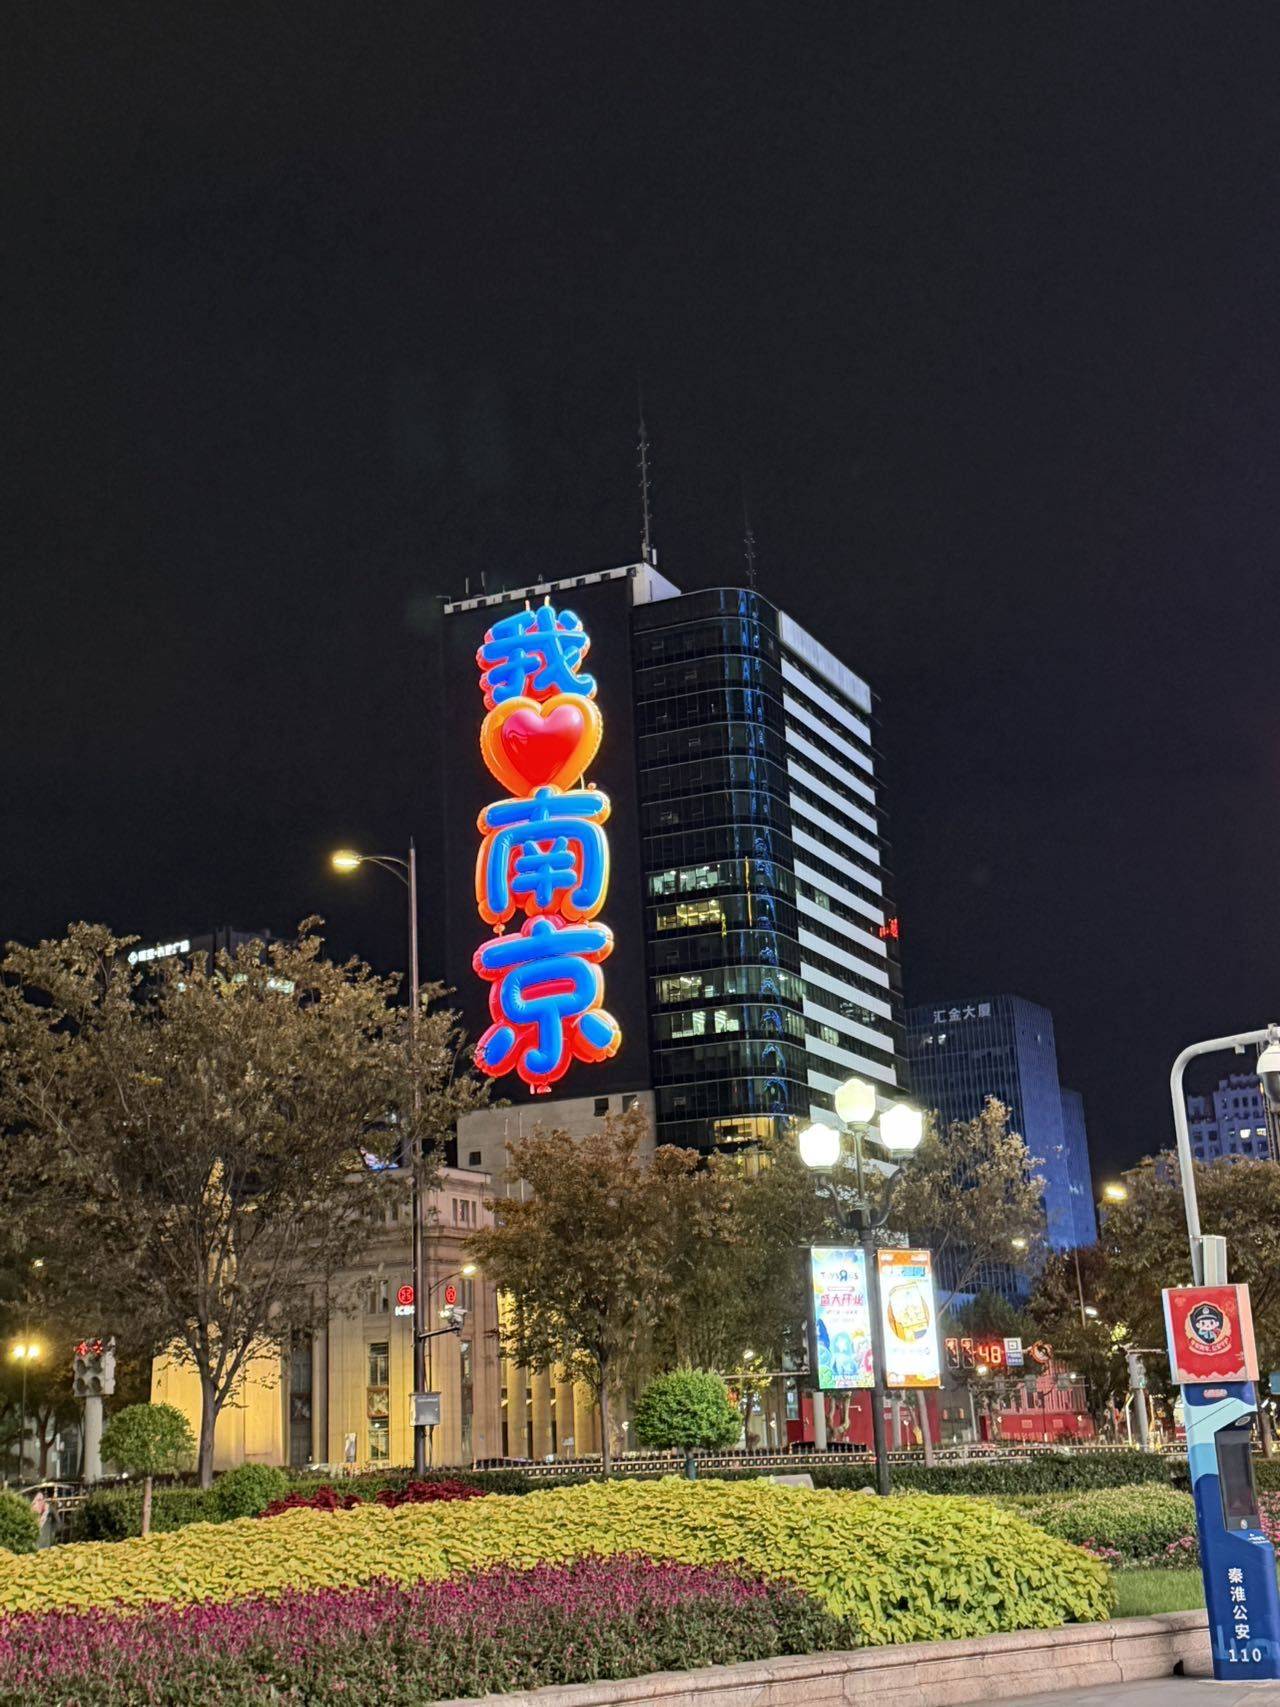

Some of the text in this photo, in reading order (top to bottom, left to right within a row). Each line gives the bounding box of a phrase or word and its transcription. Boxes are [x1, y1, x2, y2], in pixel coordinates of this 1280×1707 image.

[473, 604, 622, 1086] 我 南京
[933, 1003, 991, 1024] 汇金大厦
[979, 1345, 1002, 1364] 48
[1227, 1567, 1251, 1640] 秦淮公安
[1228, 1647, 1262, 1663] 110
